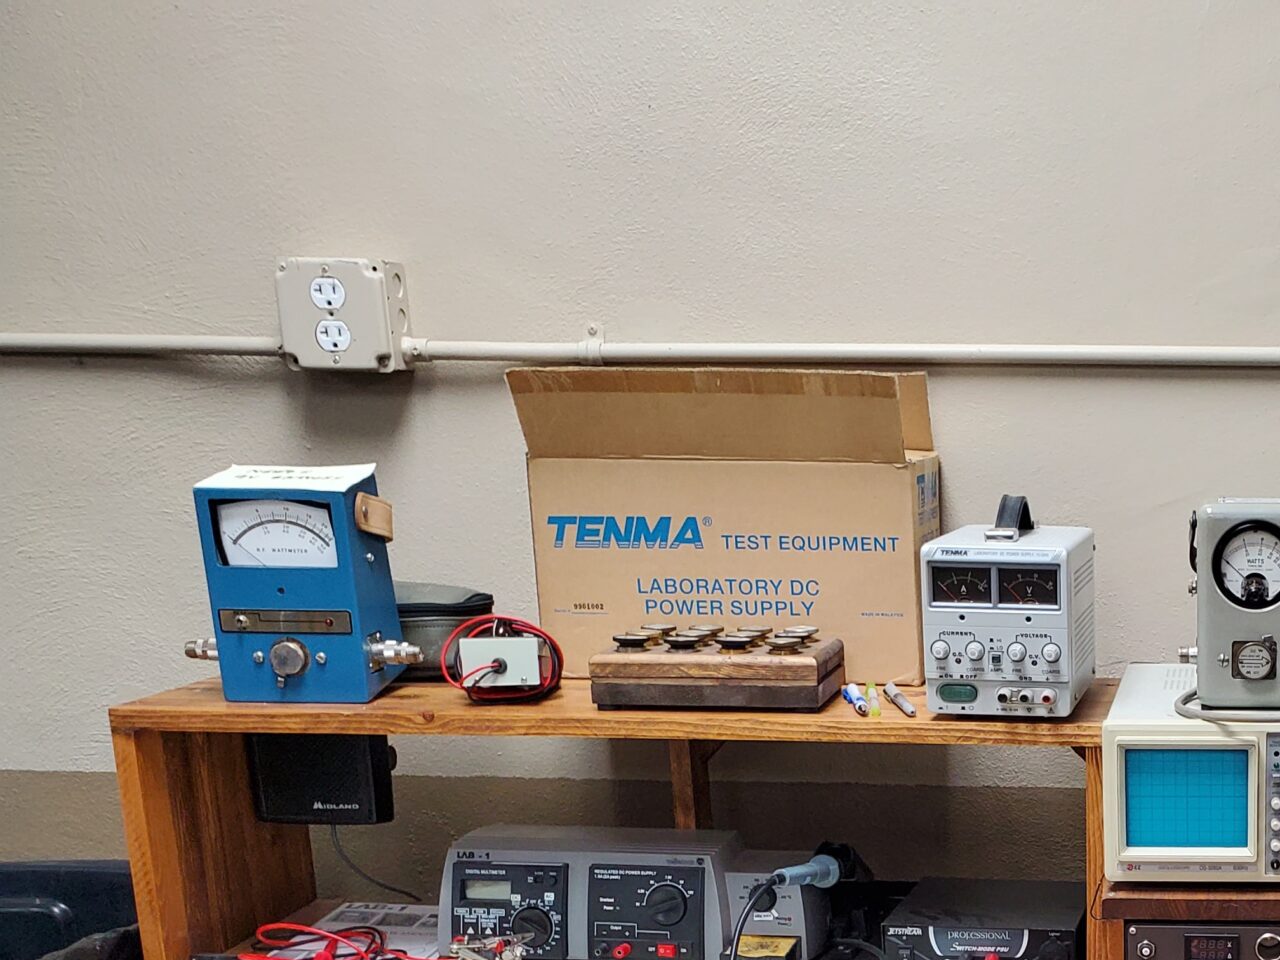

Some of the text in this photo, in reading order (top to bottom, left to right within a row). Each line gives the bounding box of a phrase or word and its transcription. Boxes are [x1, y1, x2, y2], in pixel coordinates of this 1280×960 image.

[547, 516, 704, 549] TENMA
[721, 535, 900, 552] TEST EQUIPMENT
[637, 578, 820, 596] LABORATORY DC
[646, 600, 814, 616] POWER SUPPLY
[313, 801, 360, 809] MIDLAND
[888, 927, 922, 935] JETSTREAM
[948, 931, 1010, 940] PROFESSIONAL
[951, 942, 995, 952] SWITCH-MODE
